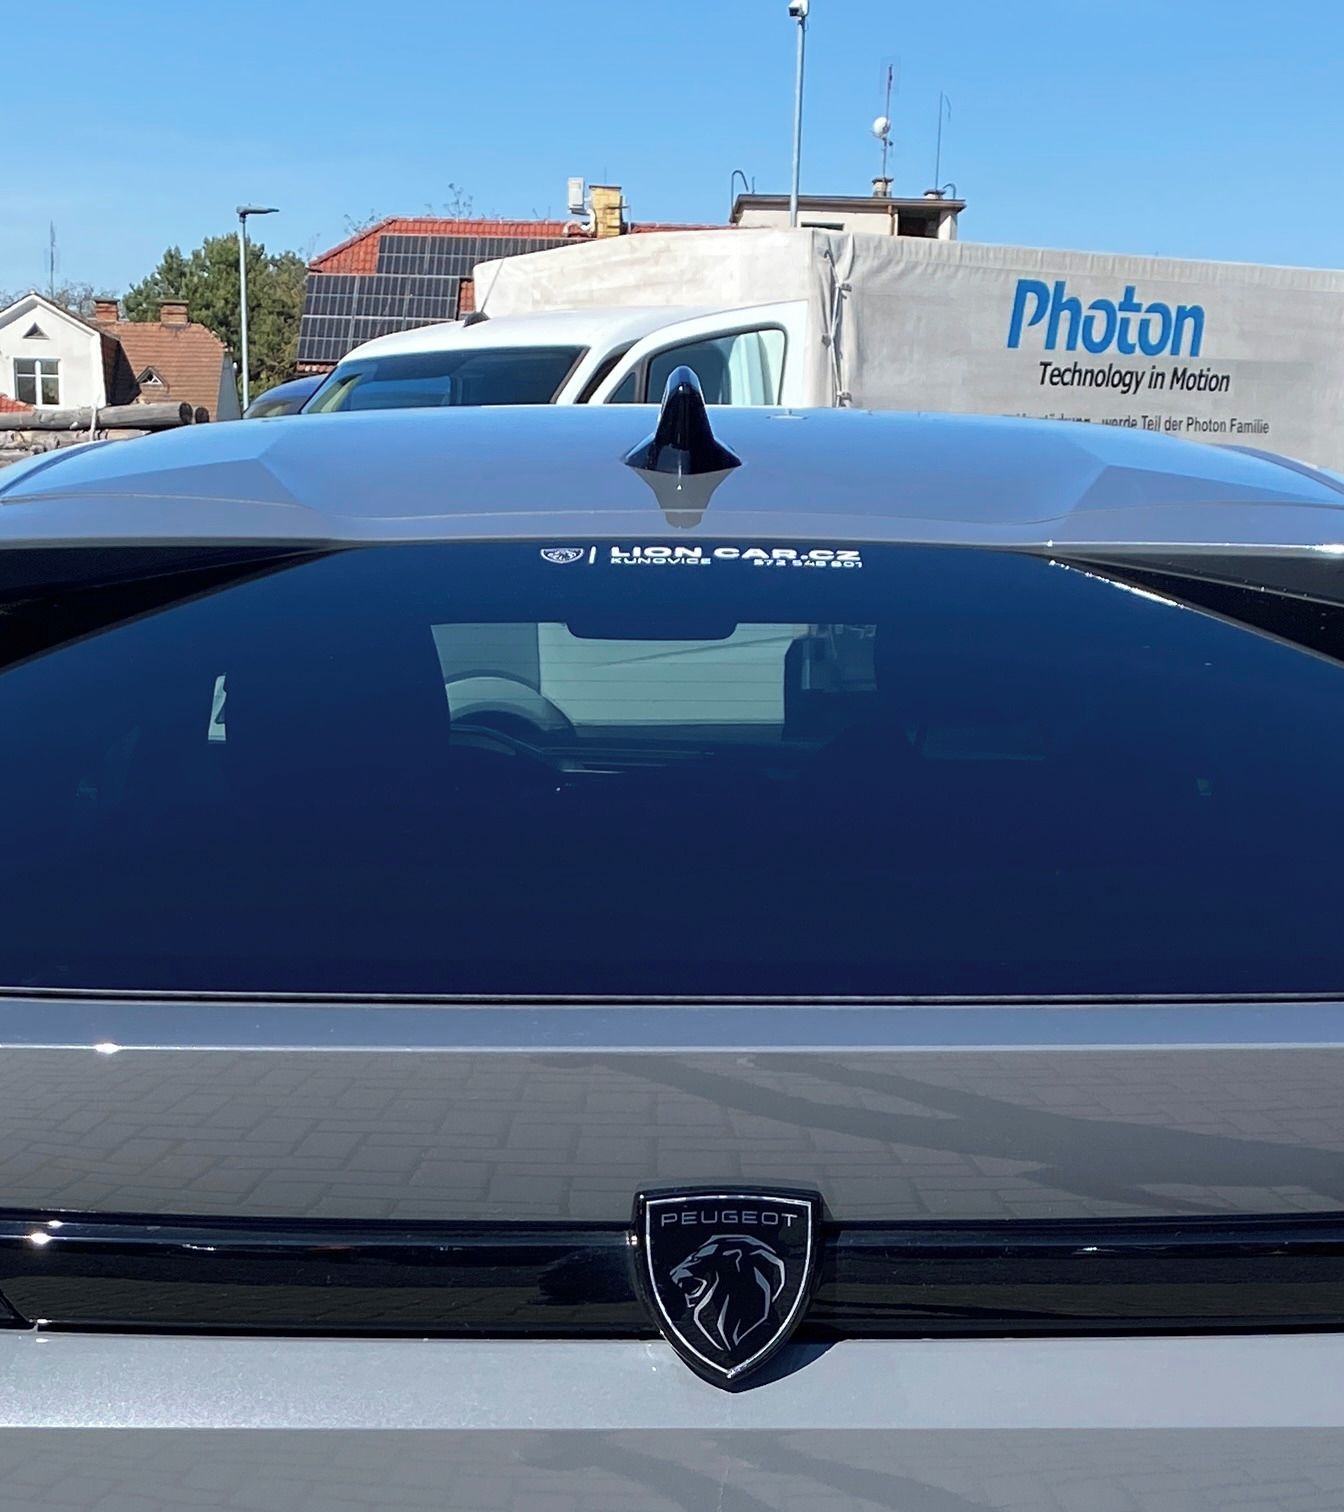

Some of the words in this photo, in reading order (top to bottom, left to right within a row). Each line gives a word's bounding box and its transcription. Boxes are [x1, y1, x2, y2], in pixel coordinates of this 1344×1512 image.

[1008, 279, 1204, 357] Photon
[1039, 361, 1145, 394] Technology
[1147, 364, 1166, 390] in
[1169, 366, 1231, 393] Motion
[1141, 415, 1161, 432] Teil
[1164, 416, 1183, 432] der
[1186, 416, 1227, 433] Photon
[1230, 418, 1270, 434] Familie
[610, 557, 712, 565] KUNOVICE
[611, 547, 702, 557] LION
[714, 548, 860, 560] CAR.CZ
[661, 1210, 799, 1227] PEUGEOT
